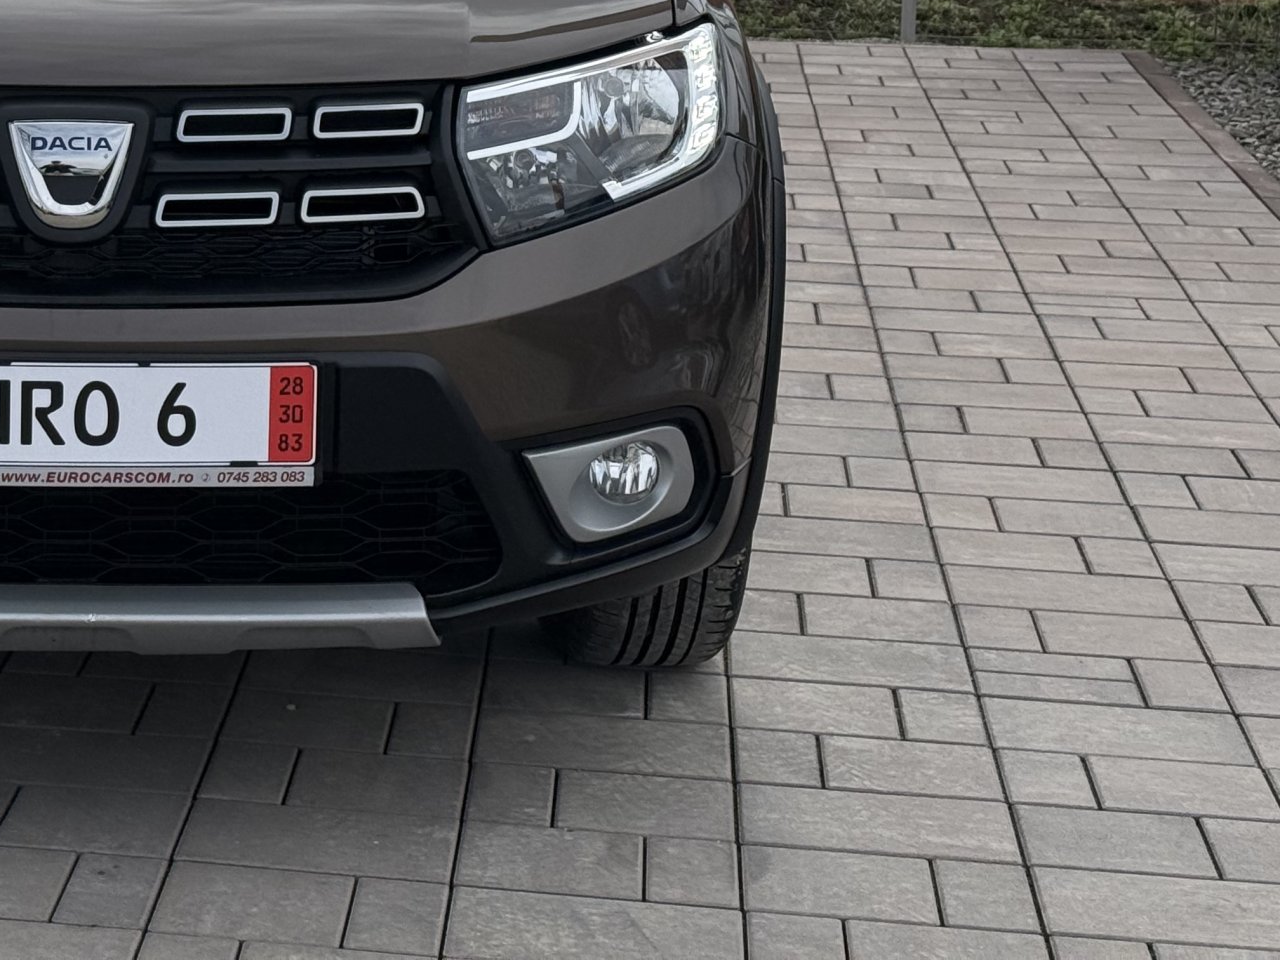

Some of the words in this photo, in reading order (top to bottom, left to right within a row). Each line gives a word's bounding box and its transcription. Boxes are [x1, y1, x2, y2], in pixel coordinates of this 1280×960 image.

[30, 136, 113, 152] DACIA
[278, 376, 304, 396] 28
[157, 382, 197, 447] 6
[278, 405, 304, 425] 30
[277, 434, 304, 453] 83
[1, 471, 194, 484] www.EUROCARSCOM.ro
[217, 471, 250, 483] 0745
[252, 471, 277, 483] 283
[280, 471, 305, 483] 083
